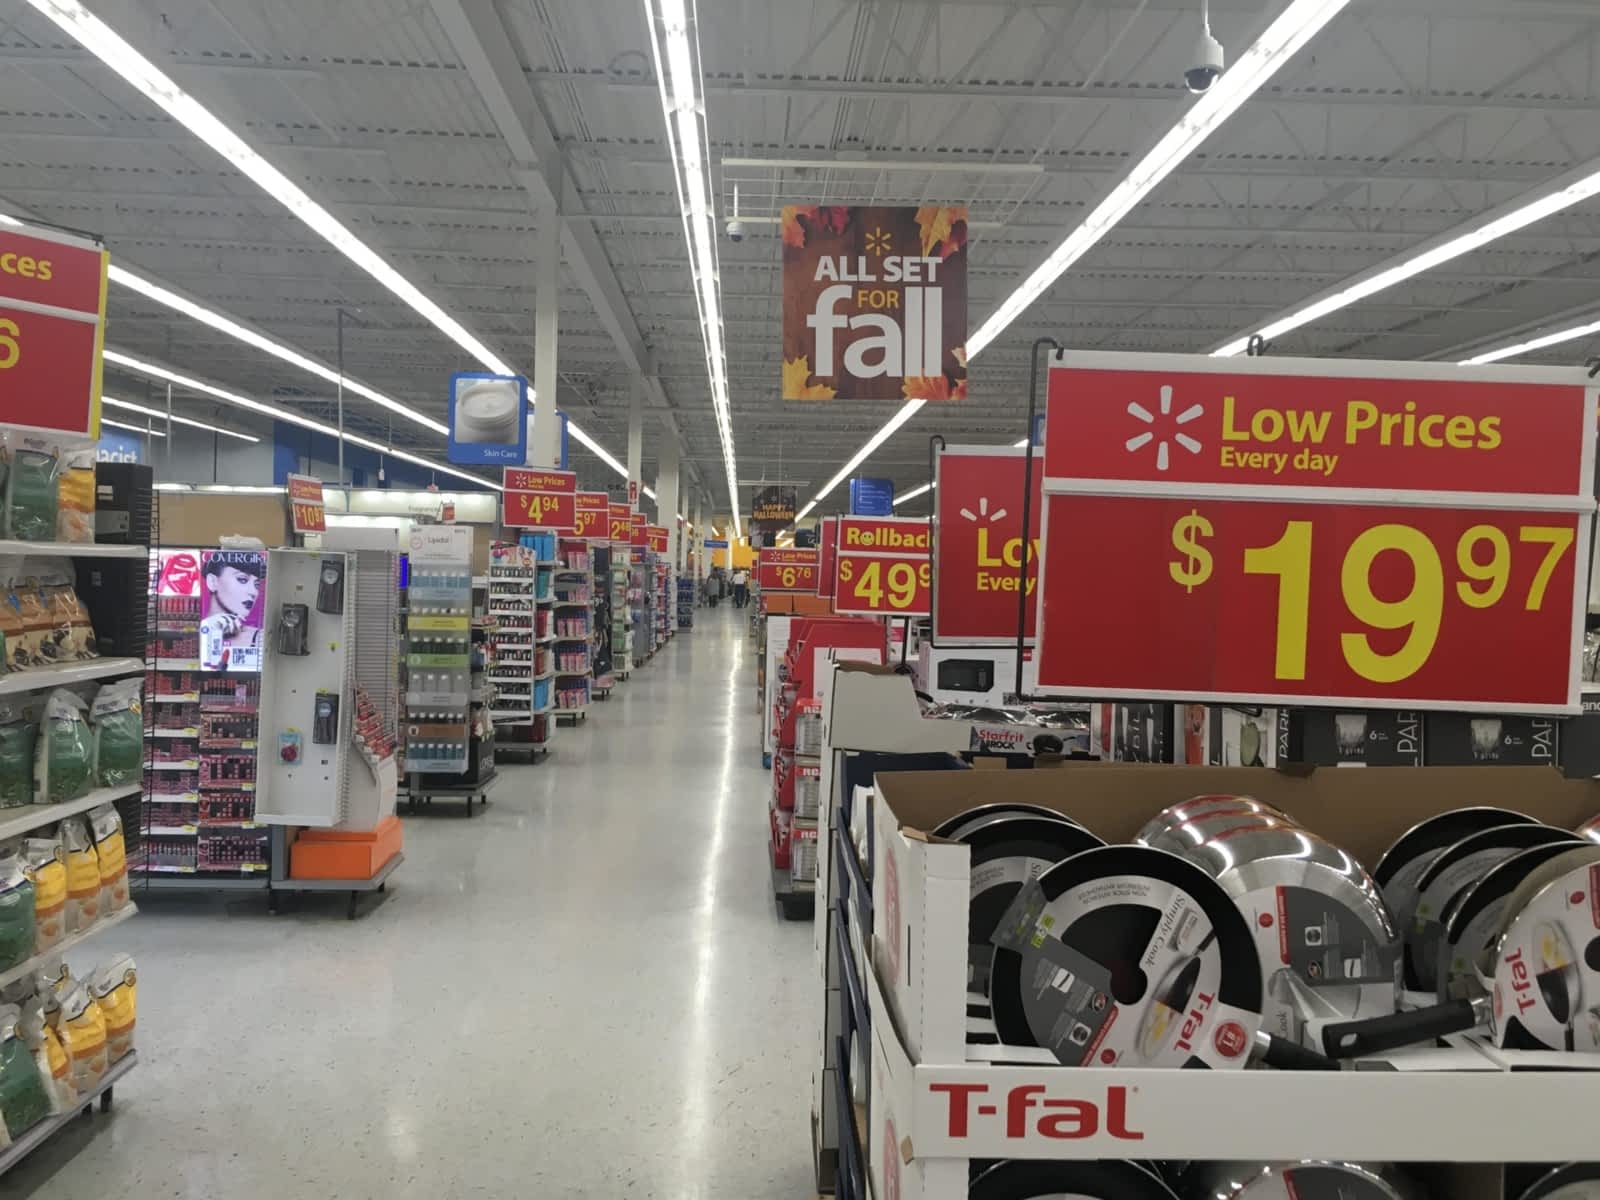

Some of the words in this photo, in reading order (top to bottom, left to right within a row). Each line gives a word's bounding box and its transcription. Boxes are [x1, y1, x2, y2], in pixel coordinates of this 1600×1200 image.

[0, 252, 52, 281] ces
[814, 255, 877, 282] ALL
[882, 255, 943, 282] SET
[857, 289, 899, 309] FOR
[806, 284, 943, 379] fall
[1221, 396, 1333, 444] Low
[1345, 400, 1503, 450] Prices
[483, 449, 501, 457] Skin
[502, 450, 518, 459] Care
[1220, 446, 1289, 475] Every
[1293, 448, 1339, 476] day
[846, 527, 931, 548] Rollbac
[803, 705, 821, 714] RC
[802, 767, 820, 776] RC
[929, 1083, 1144, 1140] T-fal
